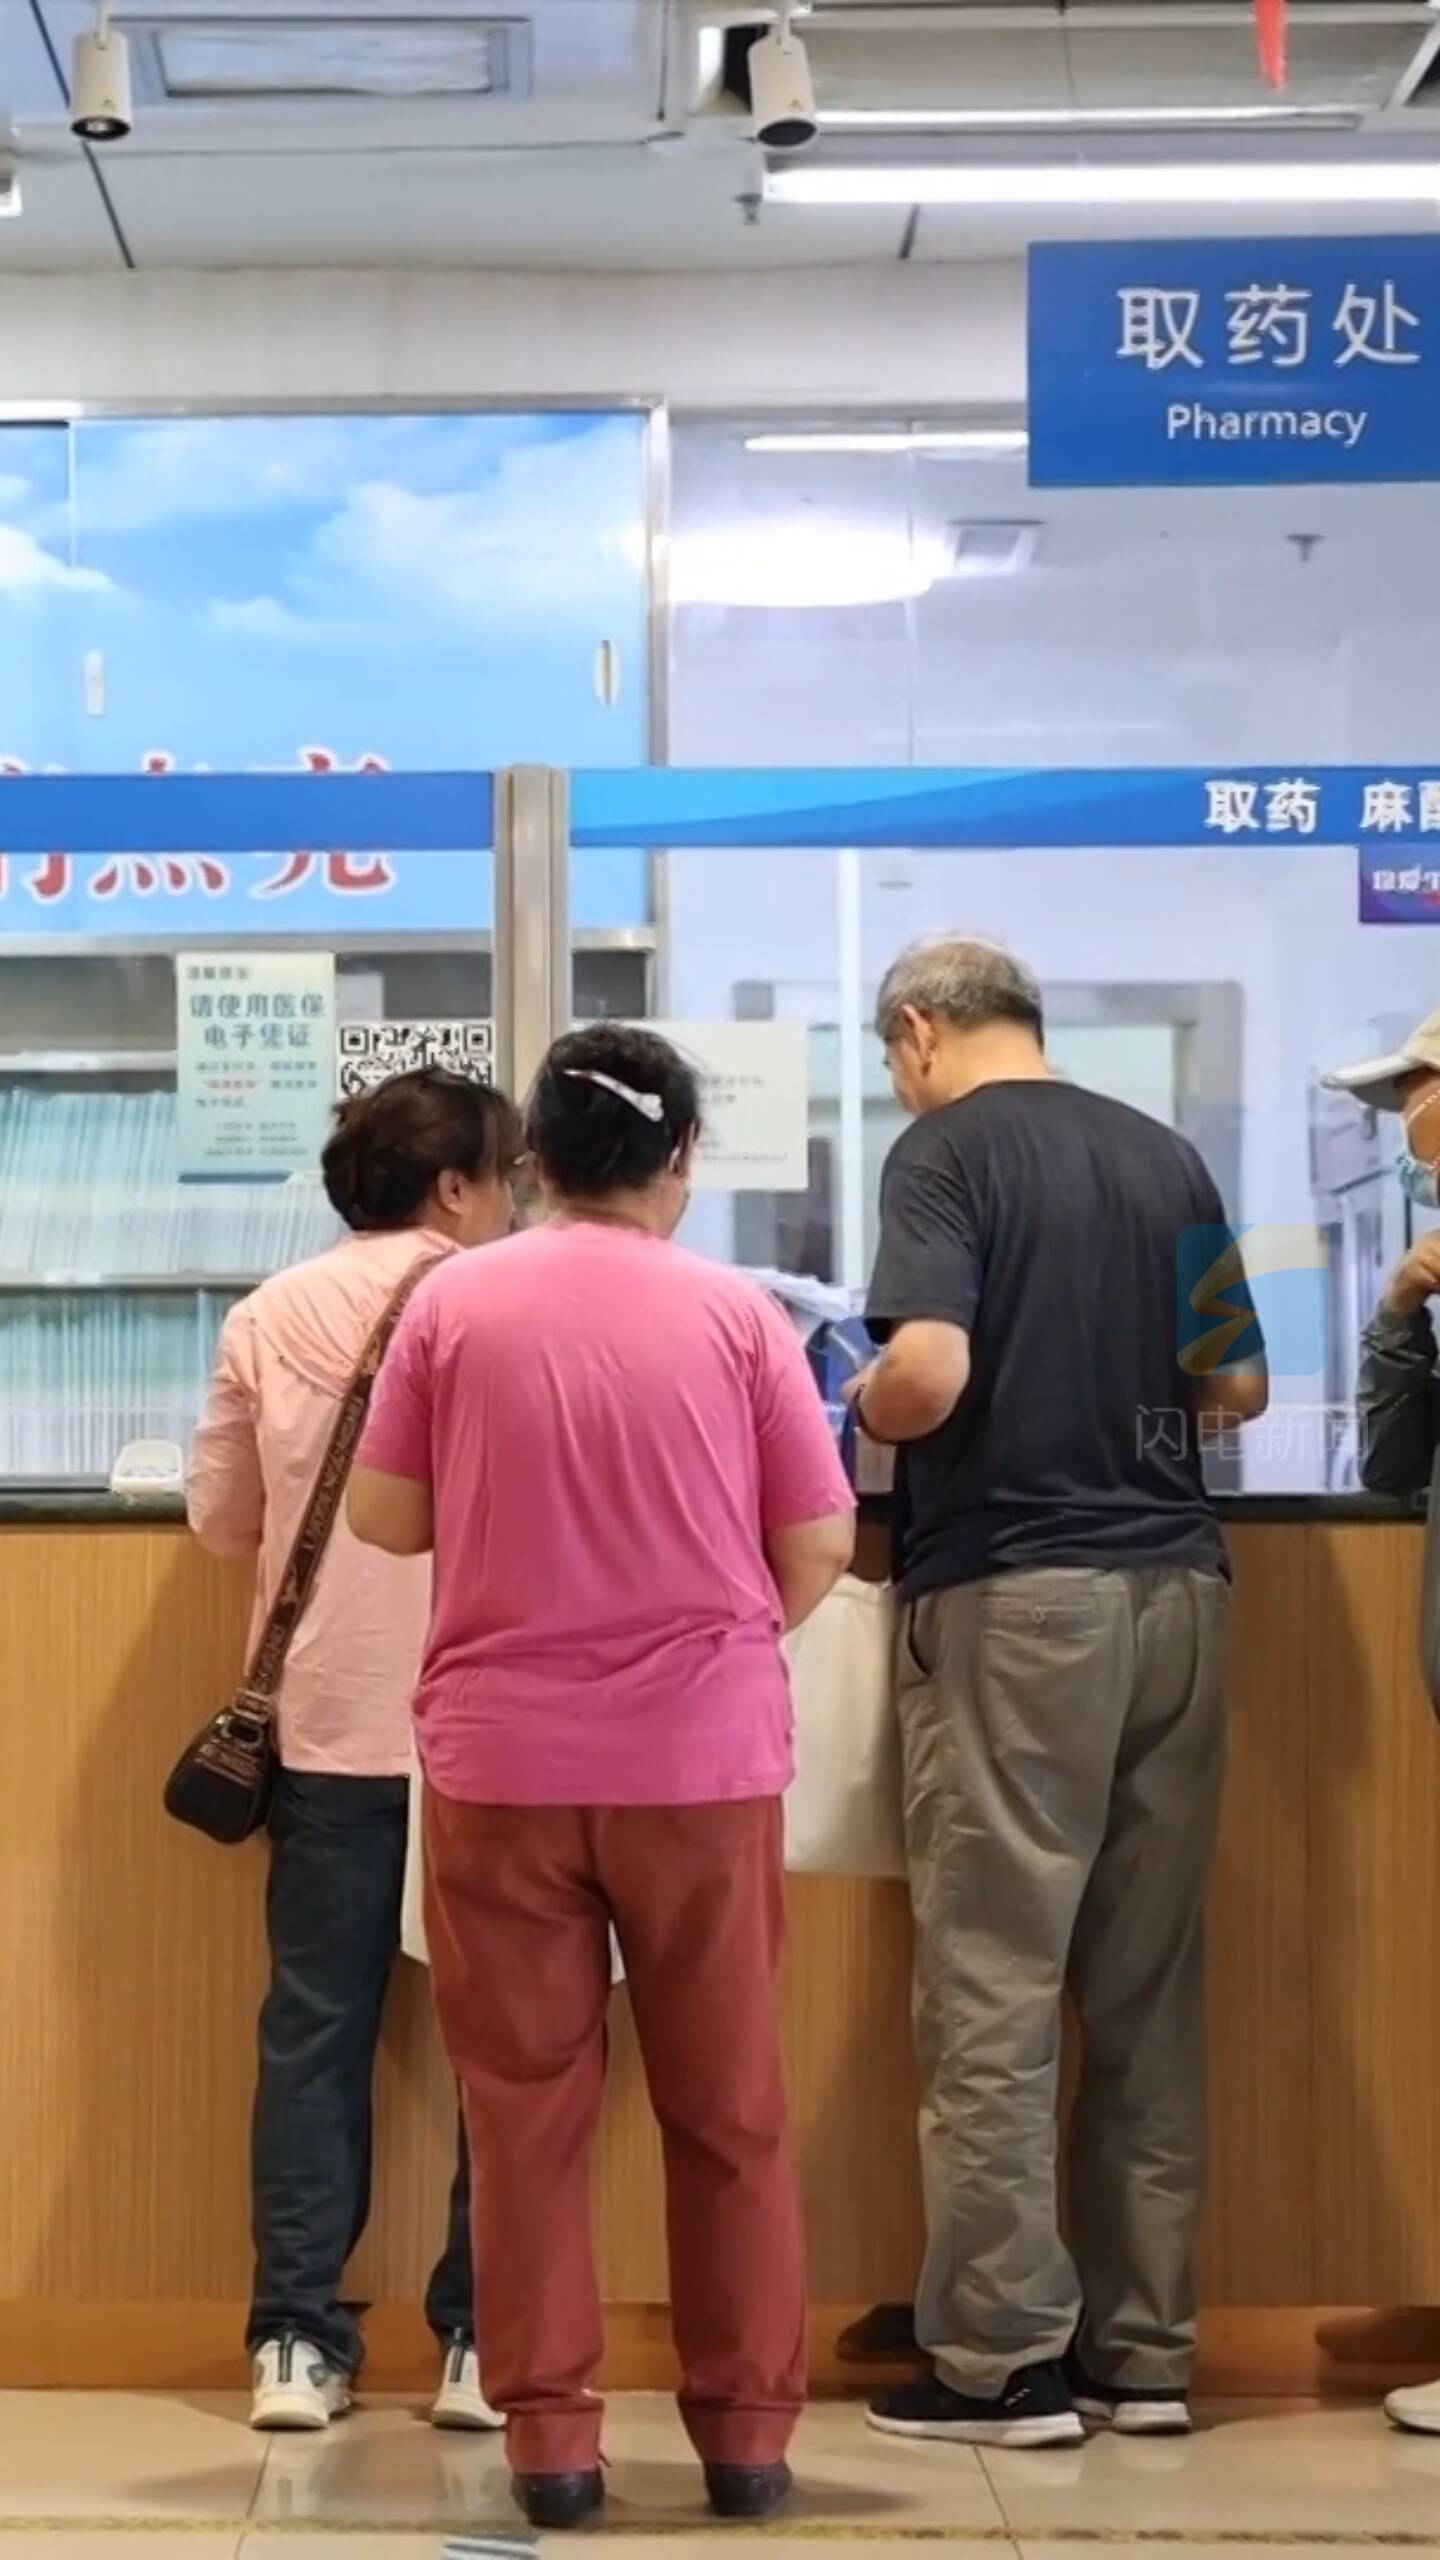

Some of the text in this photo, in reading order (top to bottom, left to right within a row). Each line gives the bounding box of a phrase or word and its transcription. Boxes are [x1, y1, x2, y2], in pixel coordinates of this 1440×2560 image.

[1115, 280, 1421, 371] 取药处
[1167, 402, 1368, 448] Pharmacy
[1203, 777, 1322, 834] 取药
[190, 993, 324, 1018] 请使用医保
[204, 1023, 312, 1049] 电子凭证
